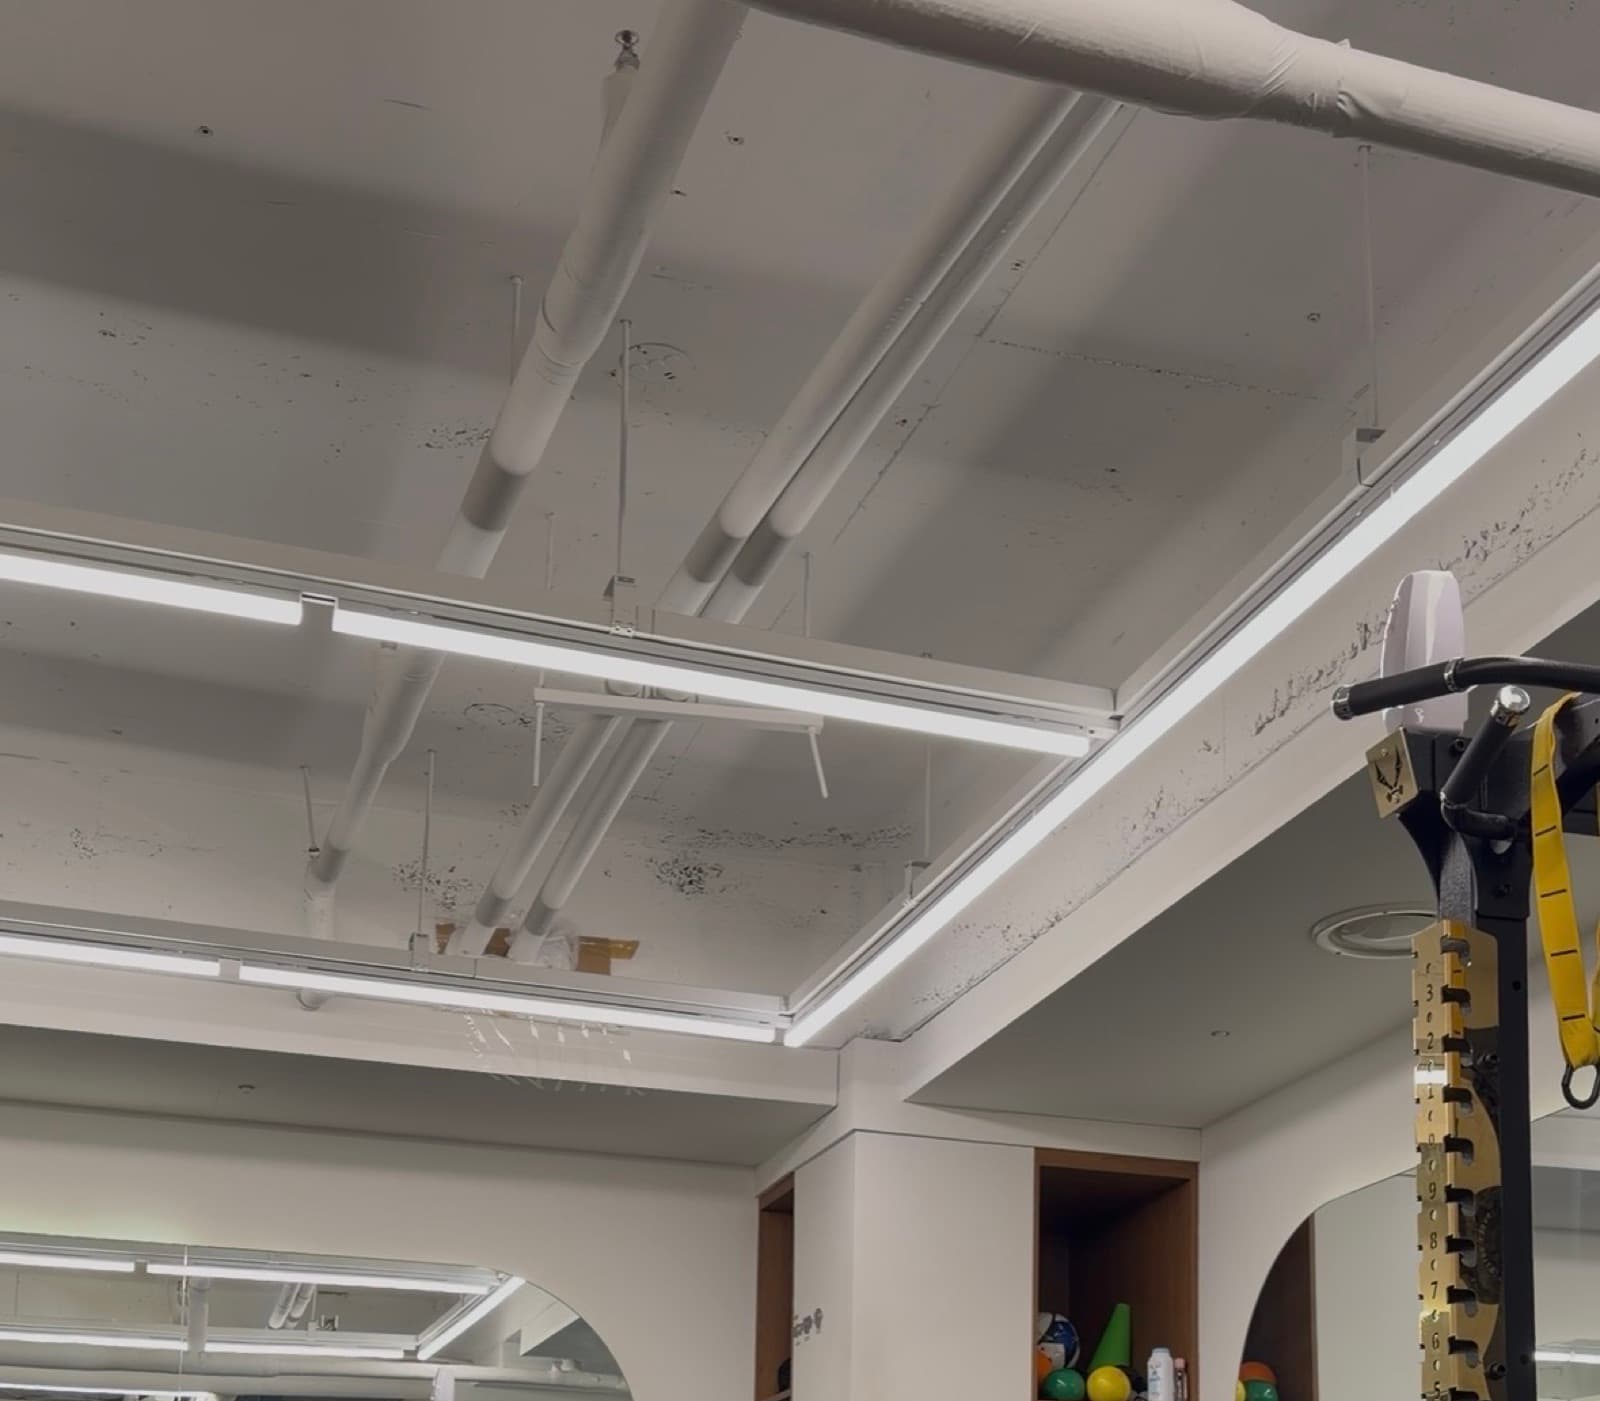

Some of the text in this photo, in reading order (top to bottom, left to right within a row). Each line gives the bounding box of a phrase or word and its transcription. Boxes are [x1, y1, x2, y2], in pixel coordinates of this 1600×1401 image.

[1426, 983, 1434, 1002] 3
[1427, 1032, 1434, 1050] 2
[1429, 1181, 1437, 1200] 9
[1430, 1232, 1438, 1250] 8
[1431, 1281, 1438, 1299] 7
[1431, 1332, 1440, 1350] 6
